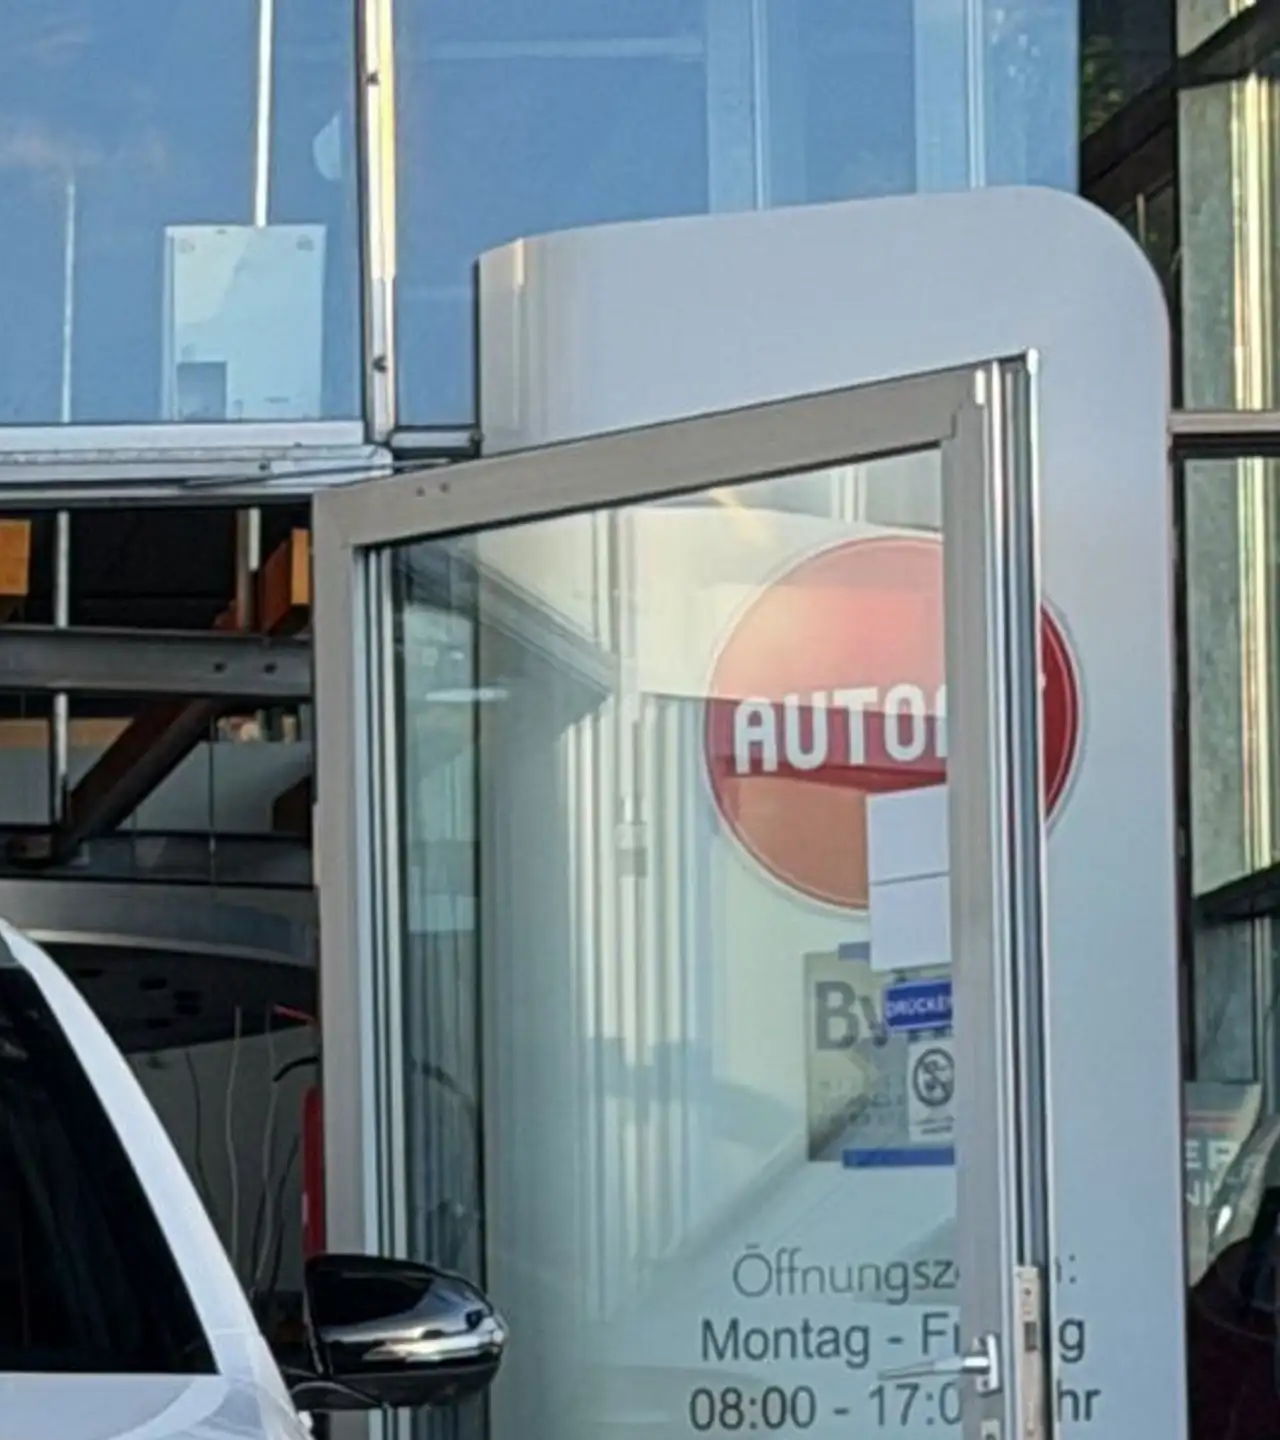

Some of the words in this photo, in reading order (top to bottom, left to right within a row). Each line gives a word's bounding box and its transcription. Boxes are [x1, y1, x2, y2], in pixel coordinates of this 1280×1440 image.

[733, 672, 1046, 775] AUTO
[700, 1317, 870, 1369] Montag
[689, 1385, 817, 1431] 08:00
[867, 1382, 961, 1427] 17:0
[1055, 1379, 1102, 1422] hr
